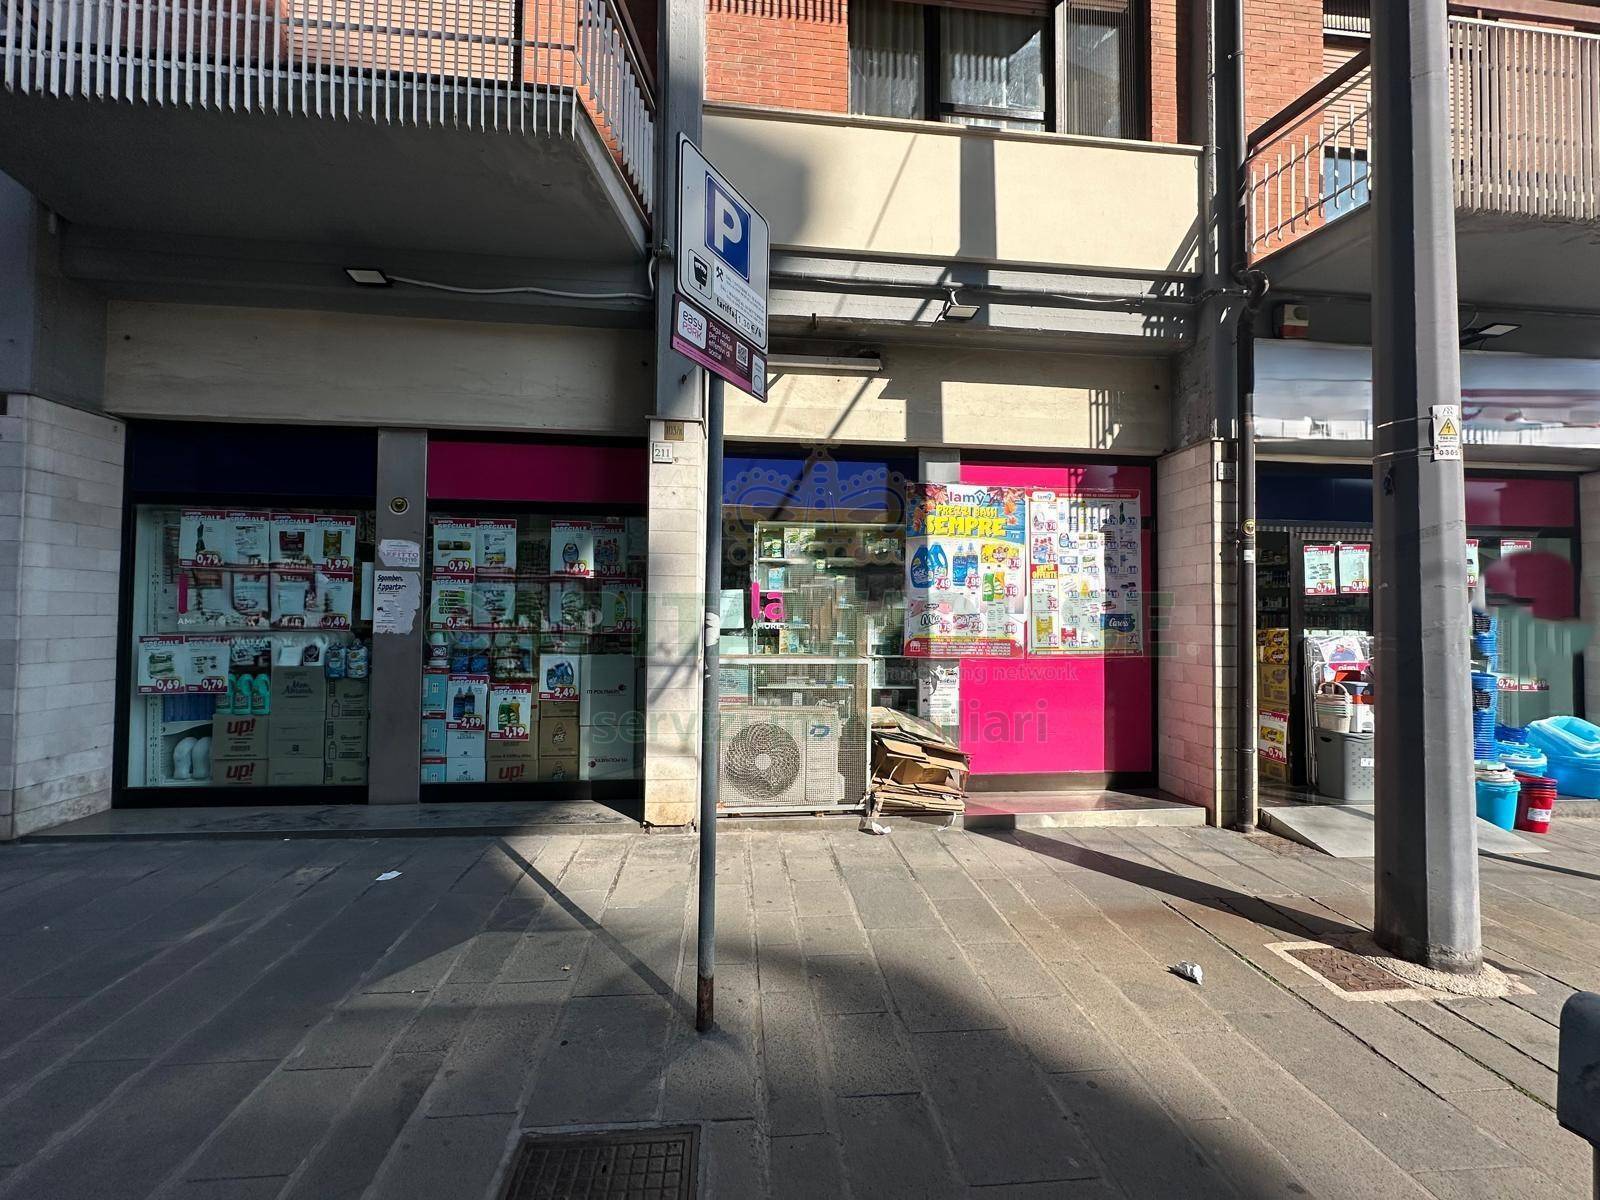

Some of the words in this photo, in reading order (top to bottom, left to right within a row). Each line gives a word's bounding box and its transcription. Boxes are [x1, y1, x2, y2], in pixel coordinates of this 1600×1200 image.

[715, 189, 742, 253] P
[683, 310, 702, 331] easy
[655, 449, 670, 458] 211
[949, 489, 986, 506] lamy
[926, 515, 1007, 537] SEMPRE
[196, 554, 219, 566] 0,79
[326, 559, 350, 570] 1,99
[448, 560, 470, 572] 0,99
[752, 582, 784, 620] la
[156, 679, 181, 692] 0,69
[202, 679, 224, 691] 0,79
[1498, 679, 1516, 689] 0,79
[554, 687, 575, 698] 2,49
[227, 718, 256, 736] up!
[460, 717, 482, 728] 2,99
[504, 726, 525, 738] 1,19
[226, 763, 255, 781] up!
[498, 763, 525, 781] up!
